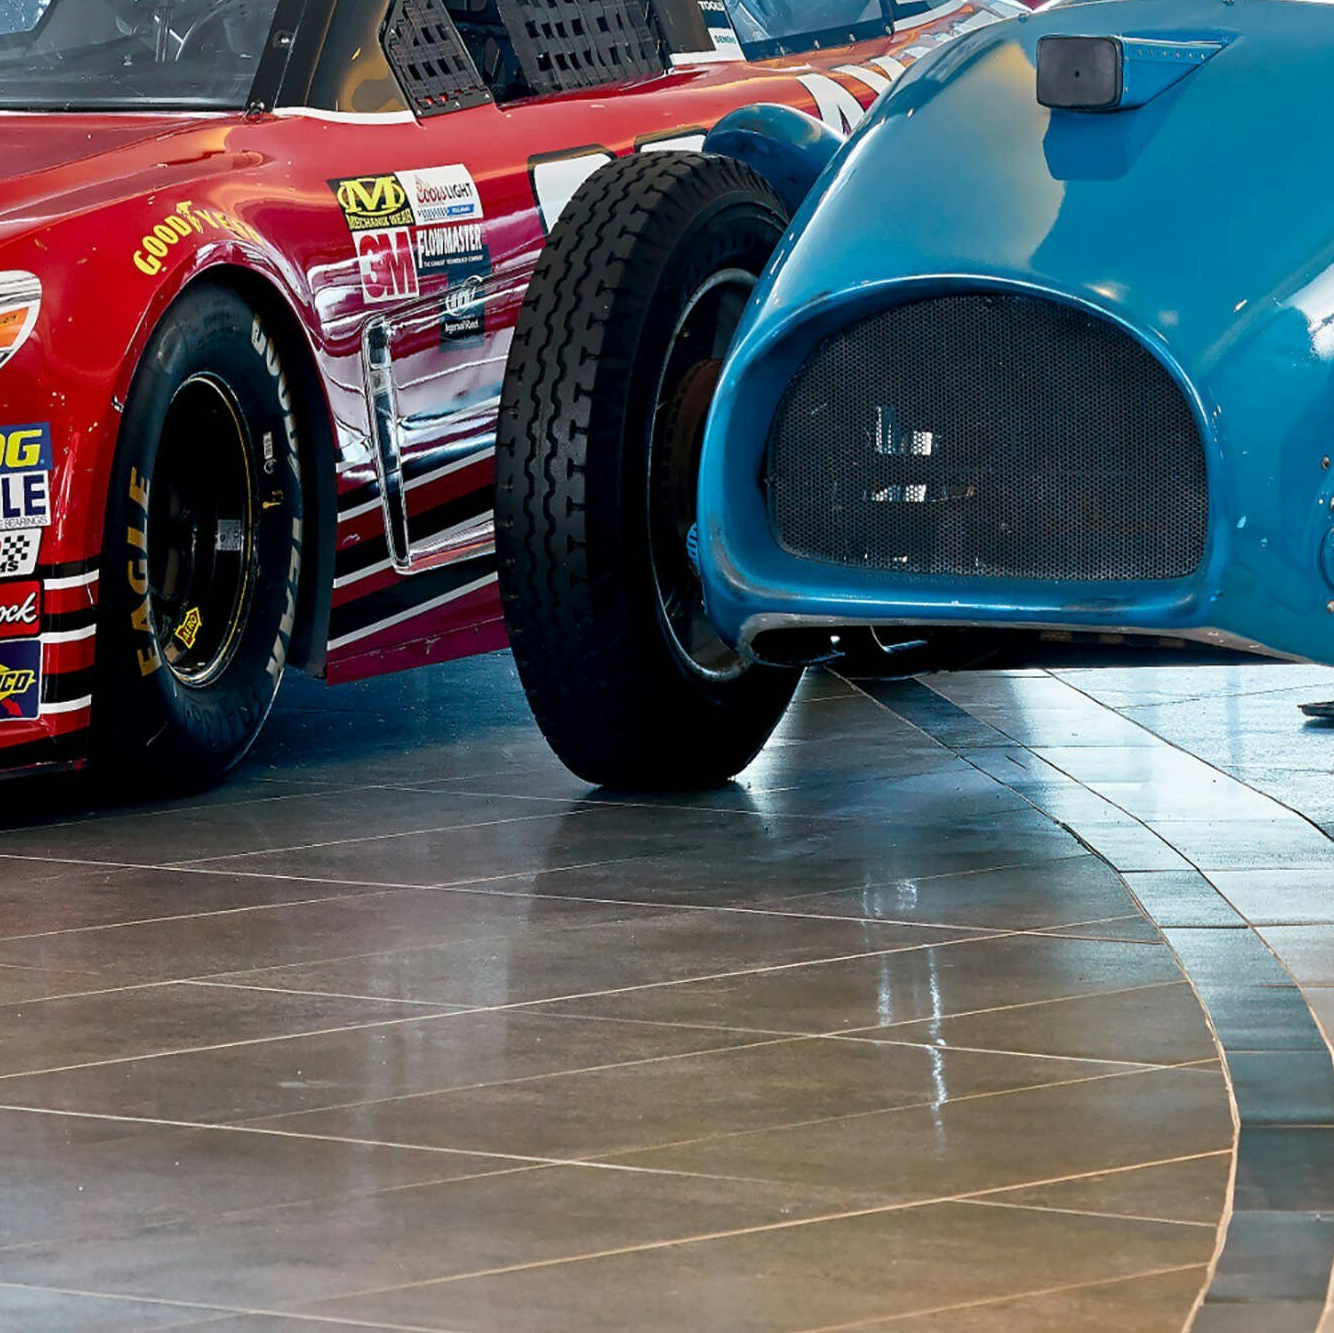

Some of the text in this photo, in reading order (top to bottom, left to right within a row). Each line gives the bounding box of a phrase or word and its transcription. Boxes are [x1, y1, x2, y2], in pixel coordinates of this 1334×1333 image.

[445, 182, 474, 200] LIGHT
[359, 231, 417, 298] 3M
[416, 223, 483, 269] FLOWMASTER
[4, 516, 48, 530] BEARINGS
[127, 466, 163, 677] EAGLE
[181, 614, 198, 642] AERO
